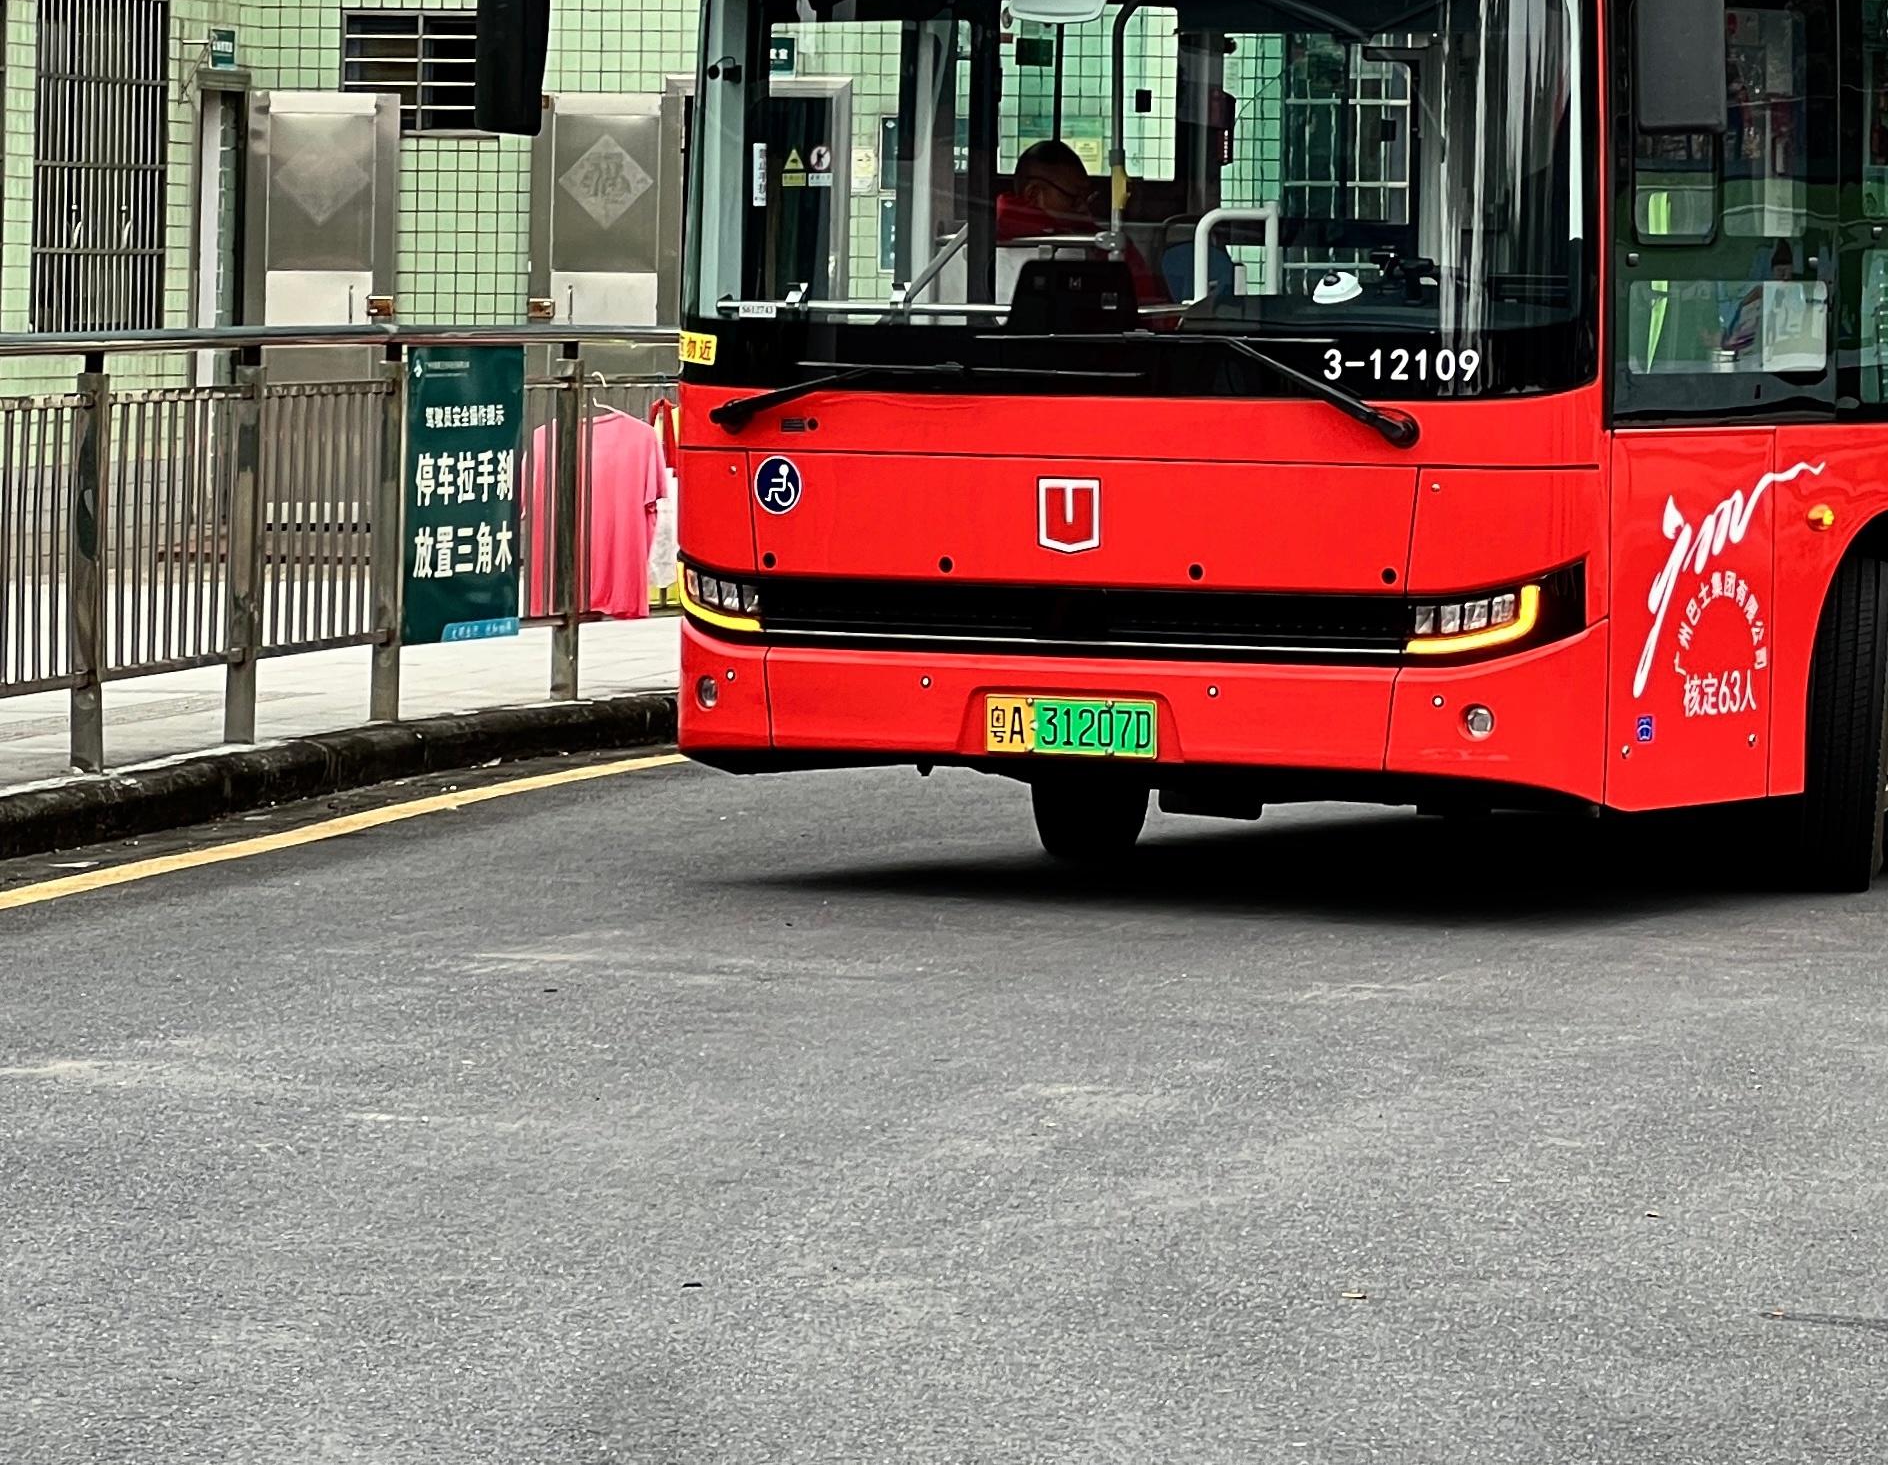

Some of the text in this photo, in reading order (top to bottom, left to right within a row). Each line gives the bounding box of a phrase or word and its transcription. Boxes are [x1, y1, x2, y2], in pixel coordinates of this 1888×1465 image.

[1323, 348, 1480, 382] 3-12109
[415, 449, 514, 507] 停车拉手刹
[412, 521, 513, 579] 放置三角木
[1673, 570, 1768, 677] 广州巴士集团有限公司
[1682, 669, 1757, 718] 核定63人
[1041, 707, 1151, 749] 31207D
